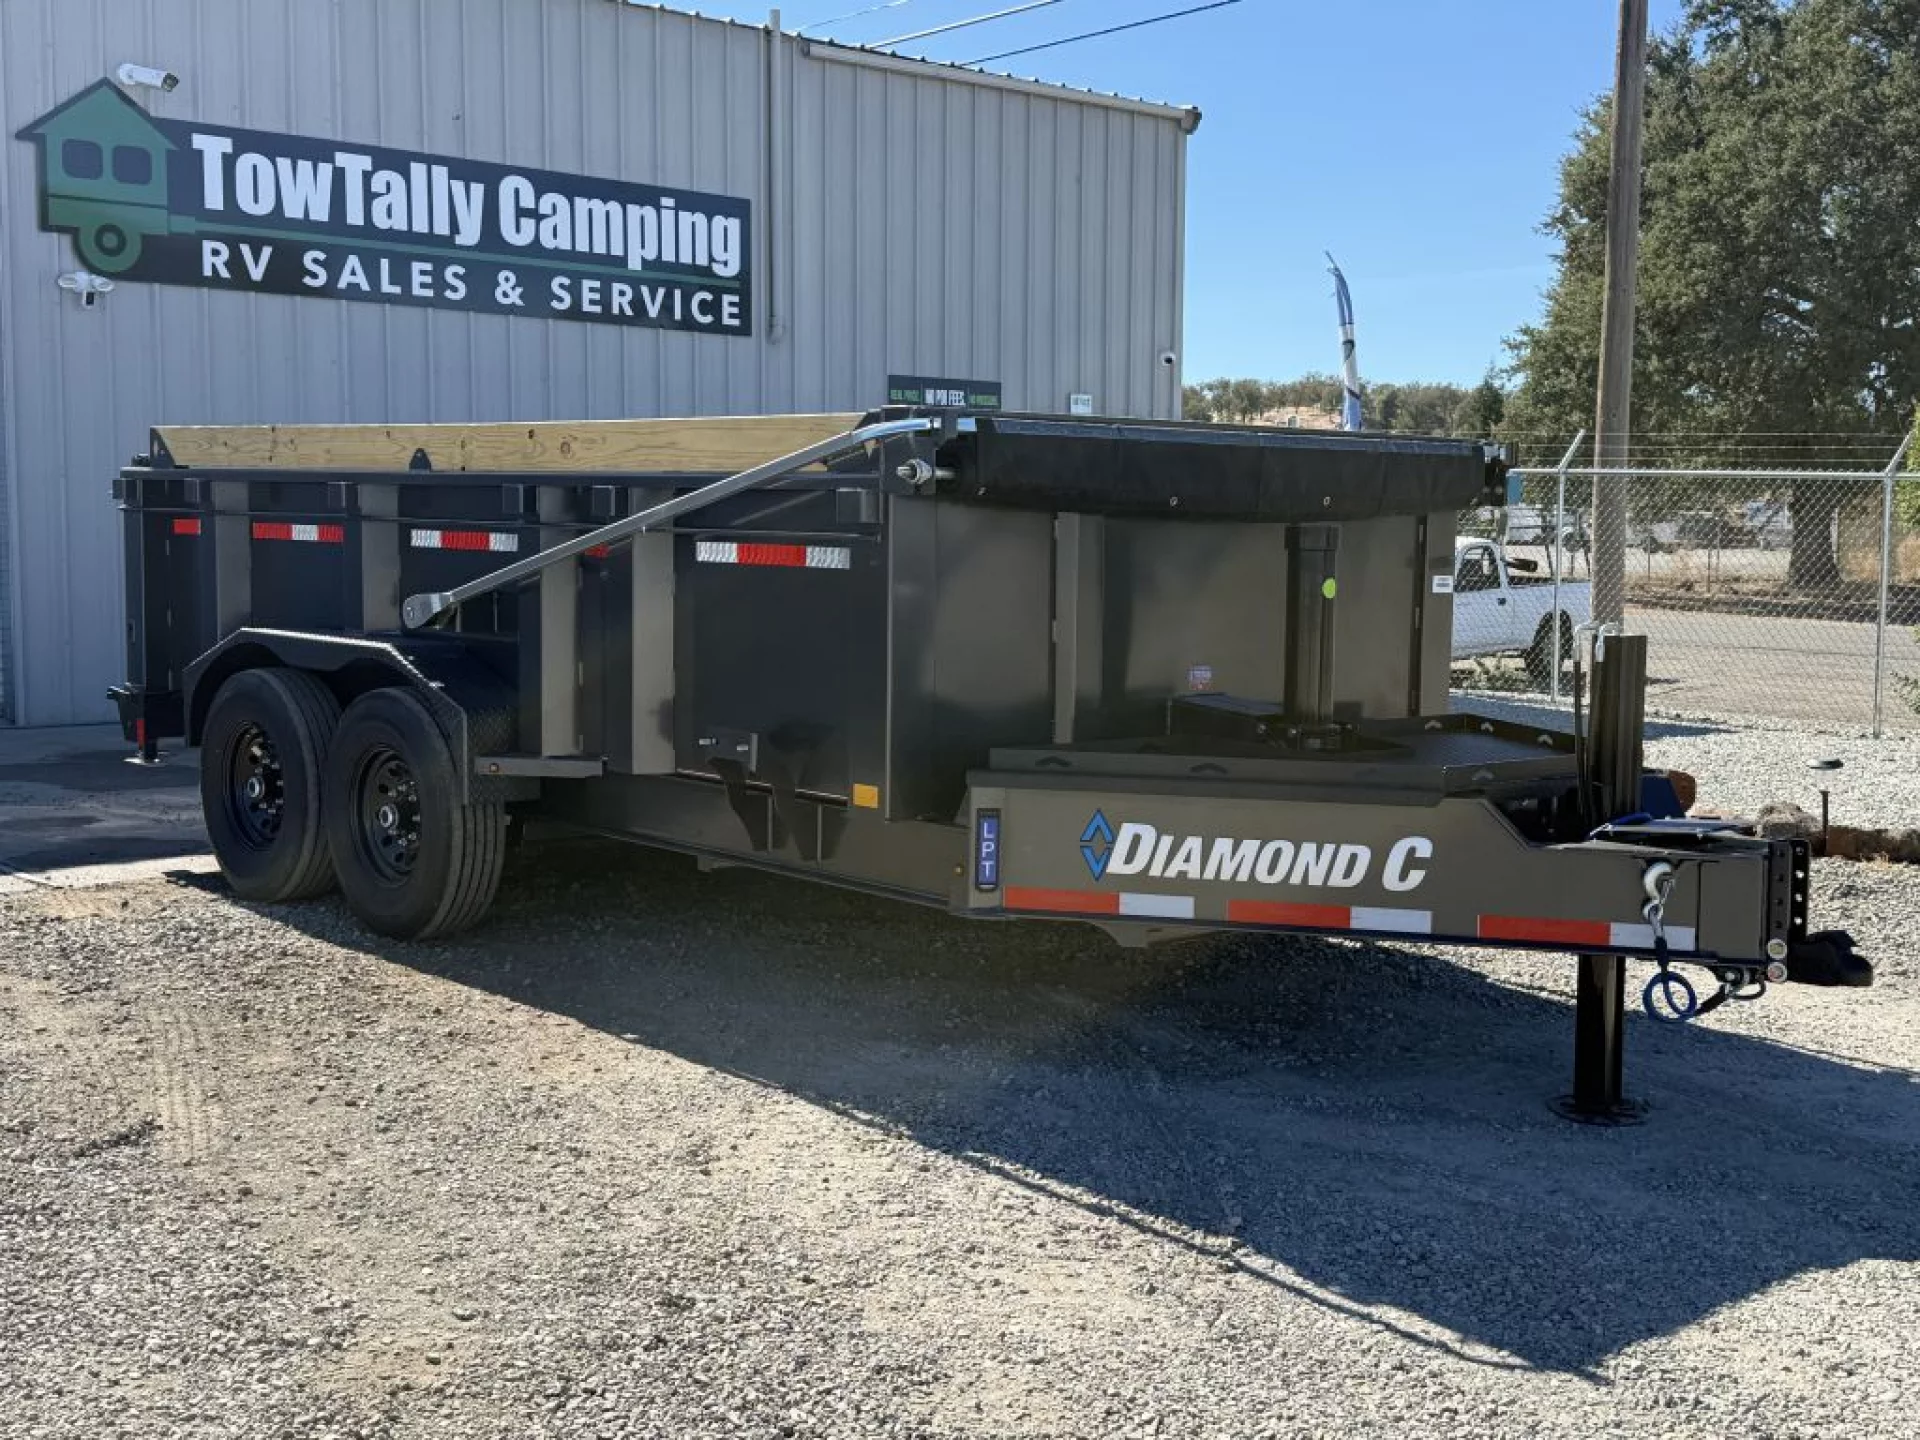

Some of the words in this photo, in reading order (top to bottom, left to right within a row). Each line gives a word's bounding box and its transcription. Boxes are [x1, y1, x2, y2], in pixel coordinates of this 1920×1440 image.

[191, 133, 484, 247] TowTally
[498, 175, 741, 277] Camping
[201, 239, 272, 282] RV
[302, 250, 467, 301] SALES
[495, 270, 525, 306] &
[550, 275, 741, 326] SERVICE
[981, 822, 995, 878] LPT
[1106, 822, 1372, 889] DIAMOND
[1382, 836, 1433, 892] C
